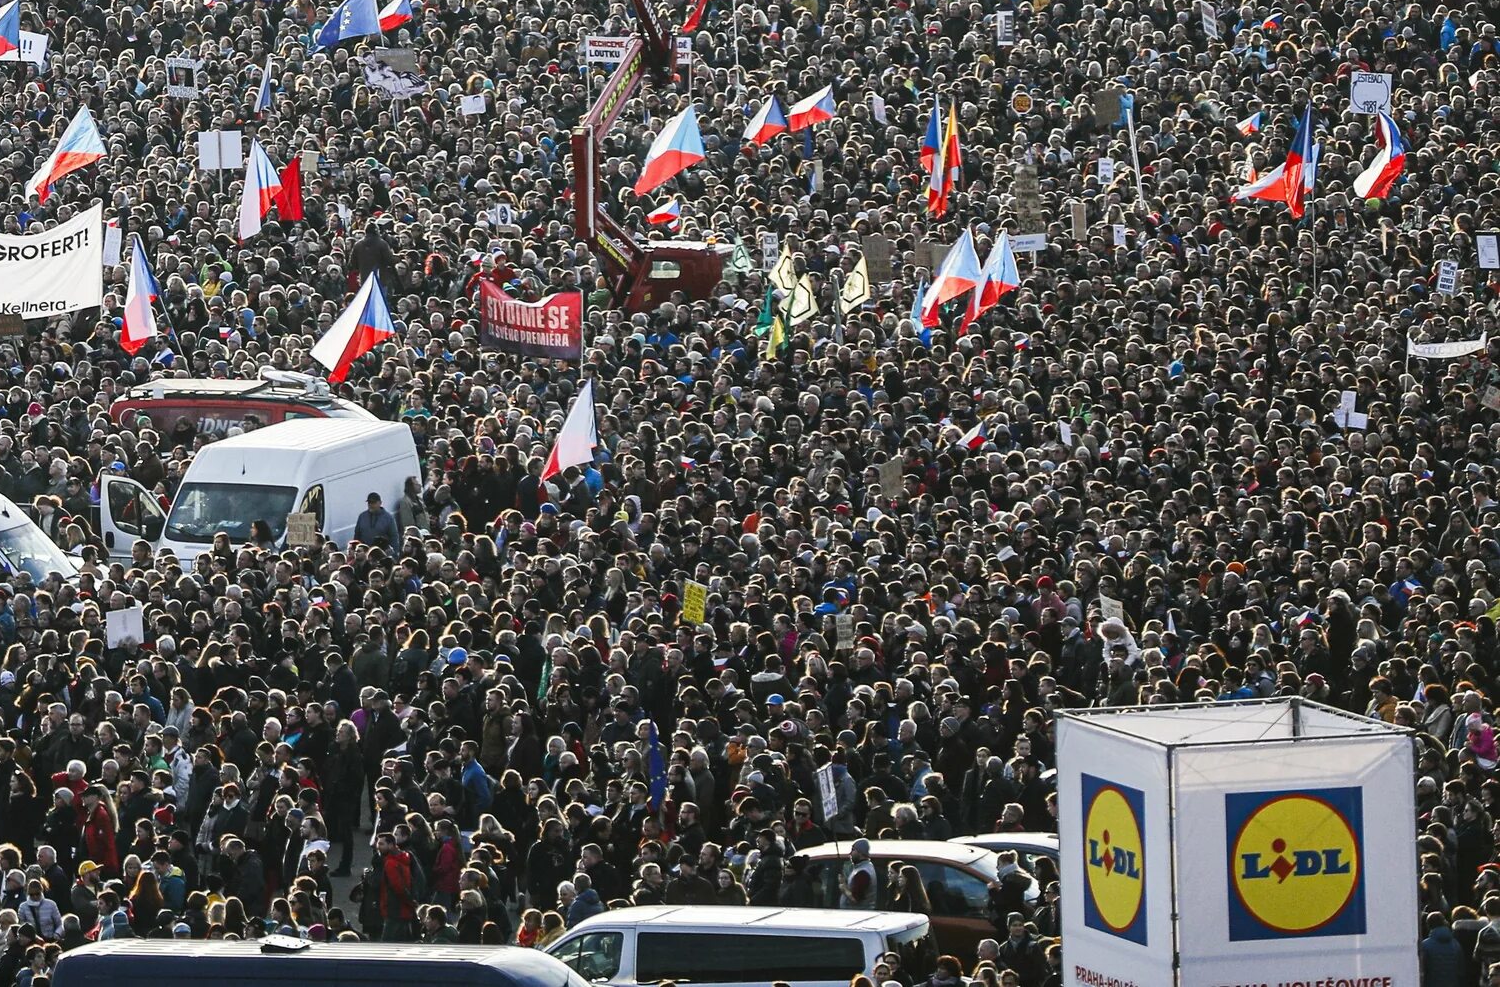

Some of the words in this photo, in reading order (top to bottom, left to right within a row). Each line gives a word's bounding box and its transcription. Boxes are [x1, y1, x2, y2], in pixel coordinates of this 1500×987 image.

[589, 50, 621, 60] LOUTKU
[2, 298, 67, 314] Kellnera
[547, 305, 570, 330] SE
